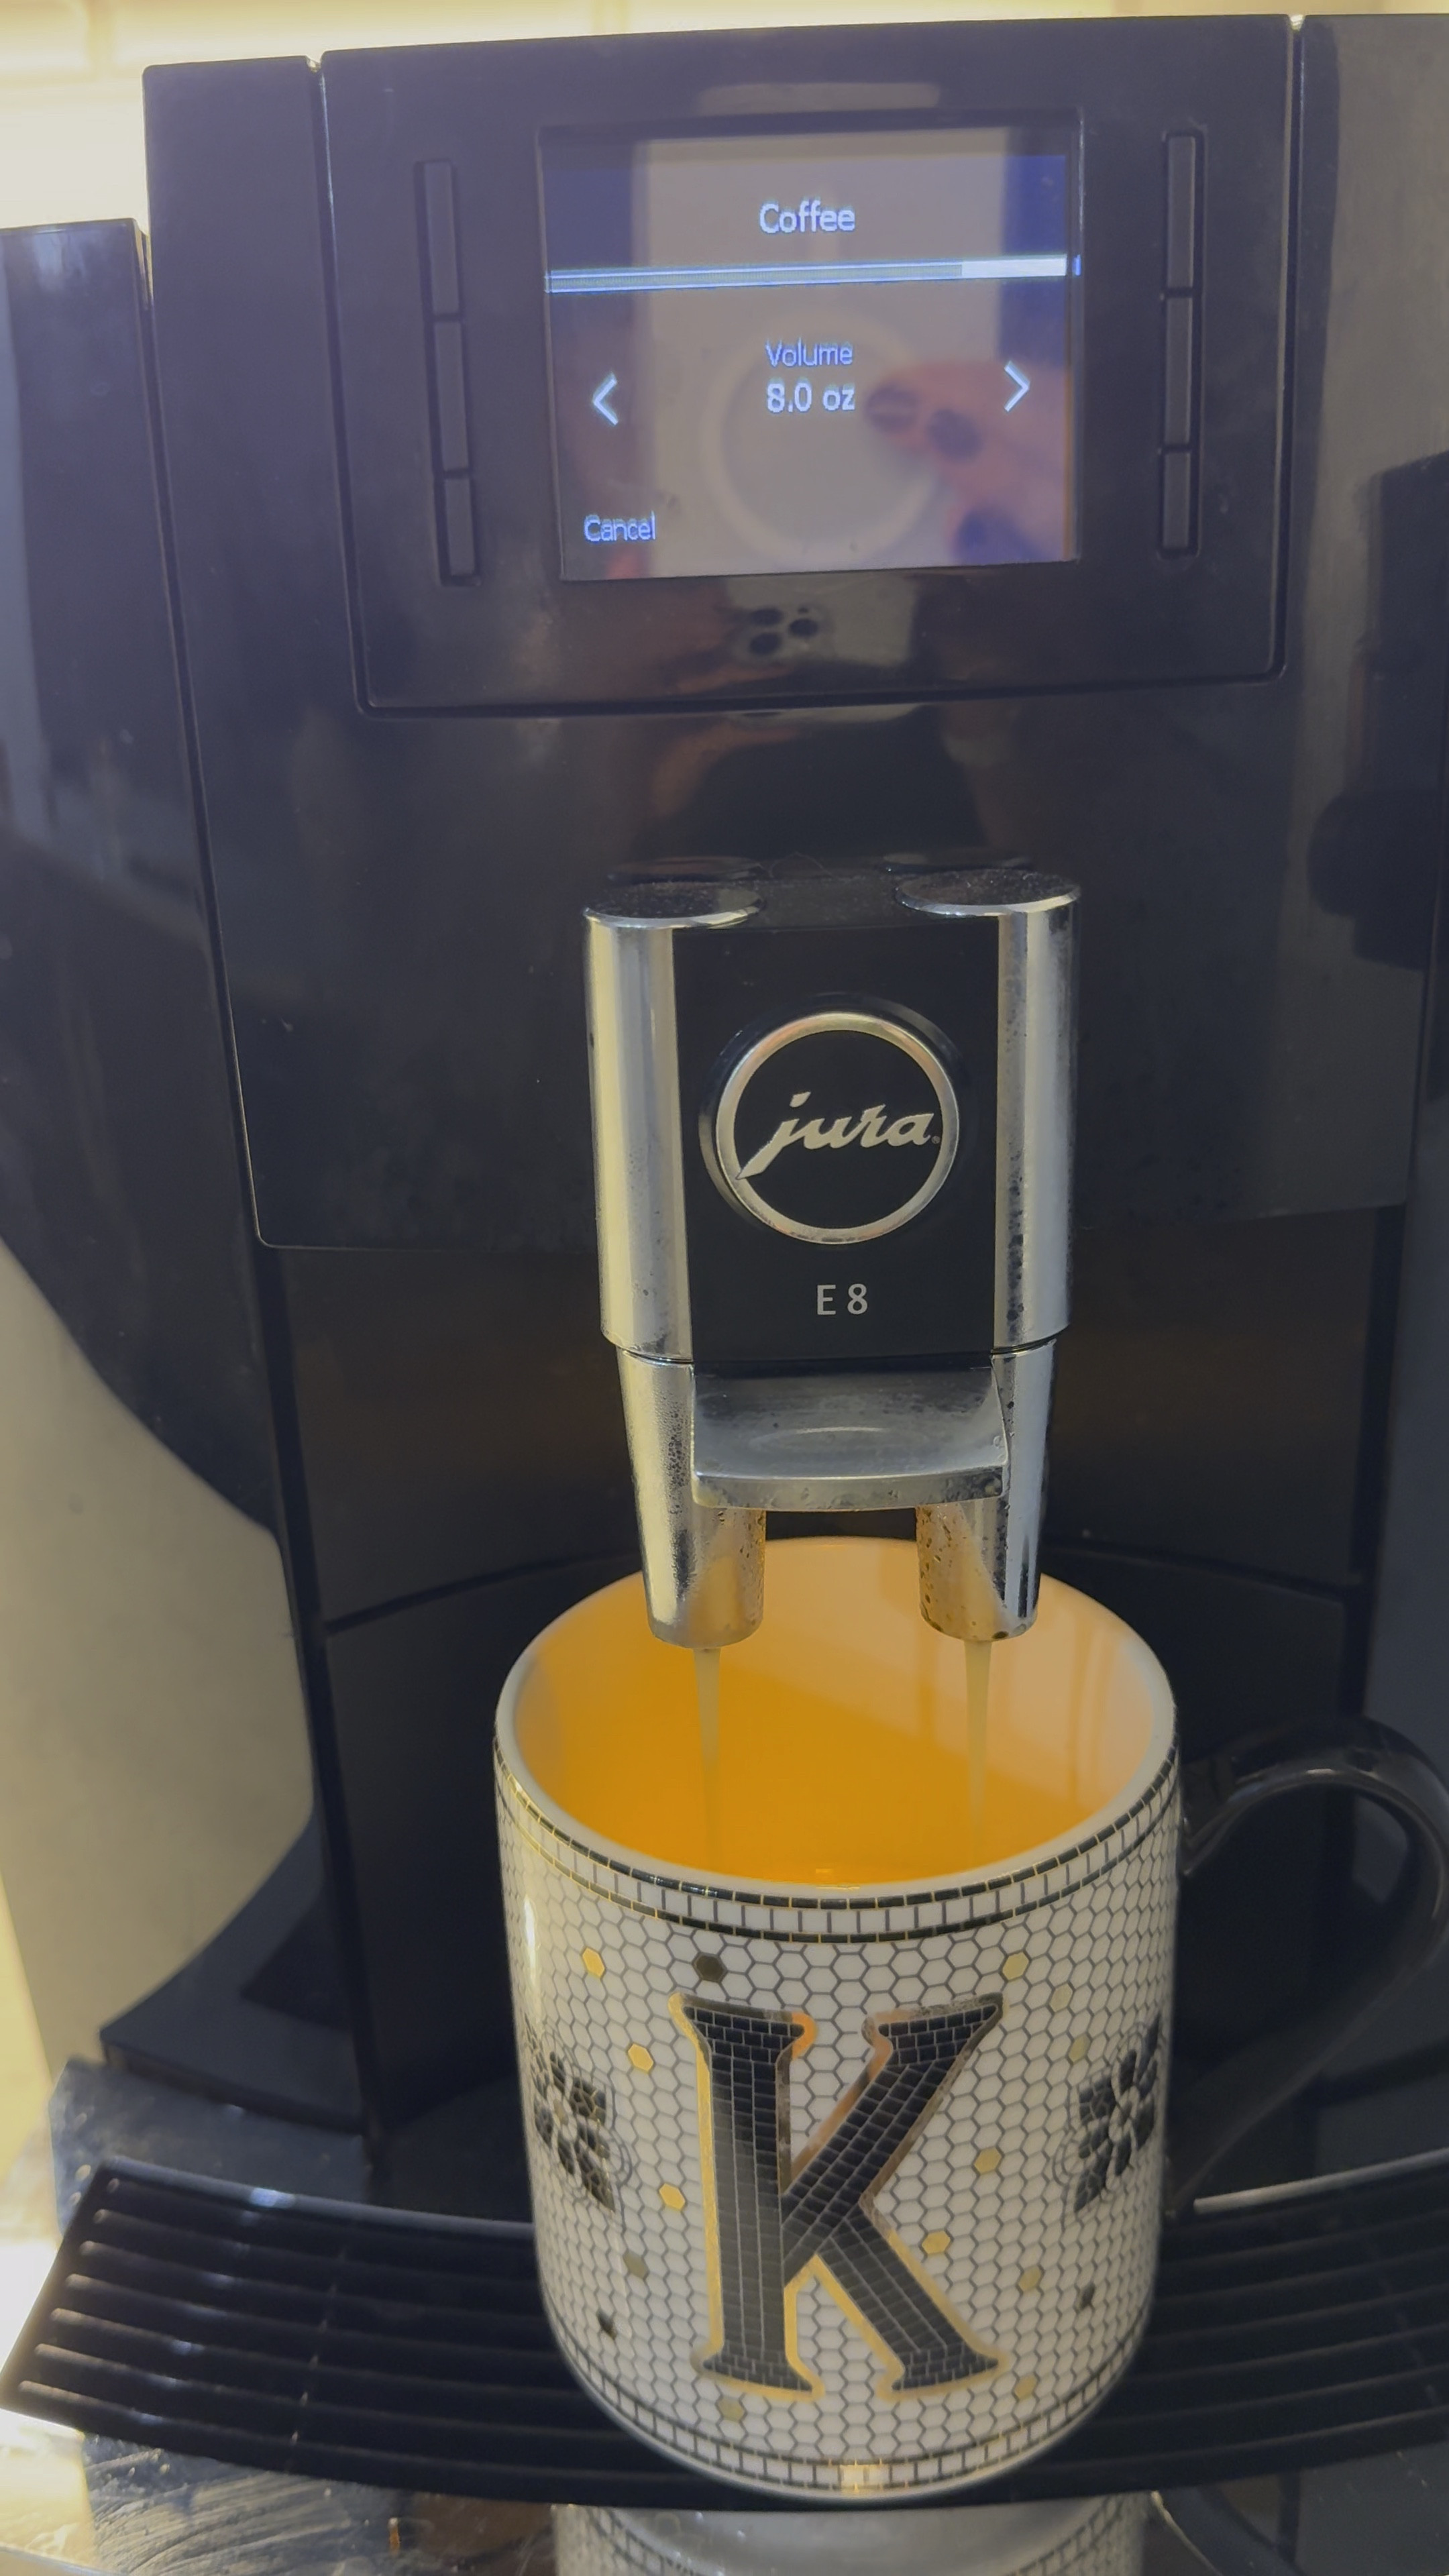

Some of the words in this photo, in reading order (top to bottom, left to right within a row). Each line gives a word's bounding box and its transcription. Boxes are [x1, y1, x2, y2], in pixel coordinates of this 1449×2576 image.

[759, 199, 855, 233] Coffee
[765, 337, 853, 367] Volume
[767, 382, 812, 413] 8.0
[822, 385, 856, 411] oz
[584, 511, 656, 542] Cancel
[737, 1091, 934, 1179] jura
[667, 1991, 1010, 2404] K
